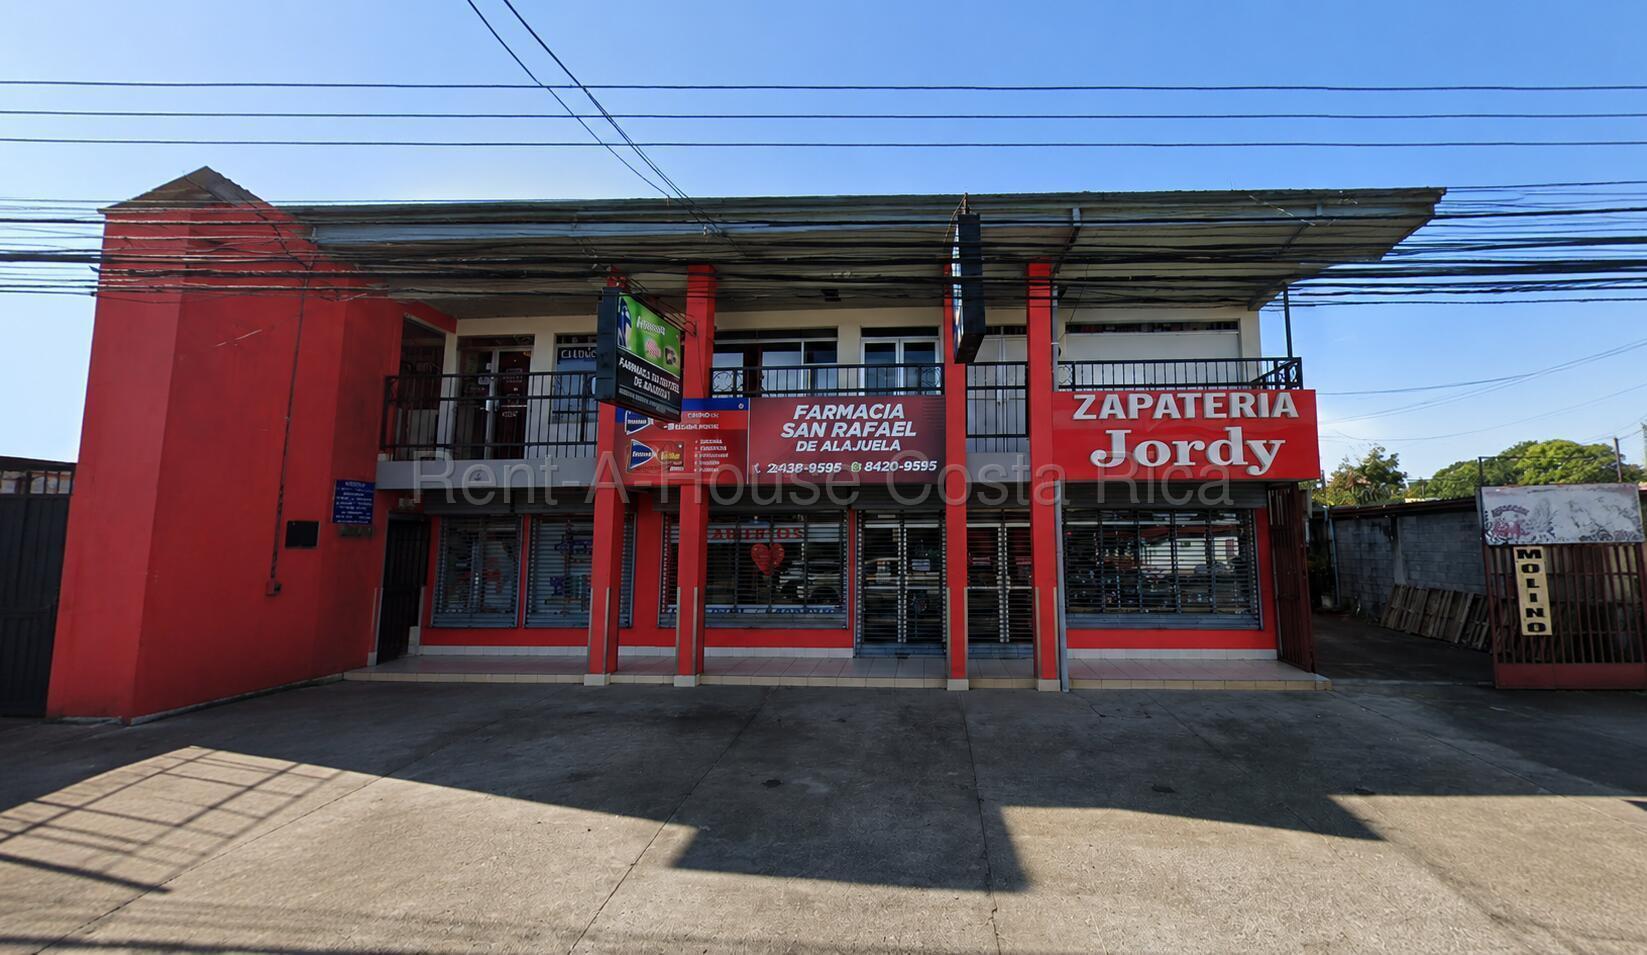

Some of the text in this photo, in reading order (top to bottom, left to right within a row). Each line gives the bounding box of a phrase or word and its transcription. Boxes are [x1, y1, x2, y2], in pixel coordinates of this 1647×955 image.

[793, 403, 905, 420] FARMACIA
[1072, 392, 1299, 420] ZAPATERIA
[780, 421, 917, 438] SAN RAFAEL
[795, 439, 901, 452] DE ALAJUELA
[1089, 426, 1286, 476] Jordy
[766, 460, 937, 474] 2438-9595 8420-9595
[1516, 549, 1547, 632] MOLINO
